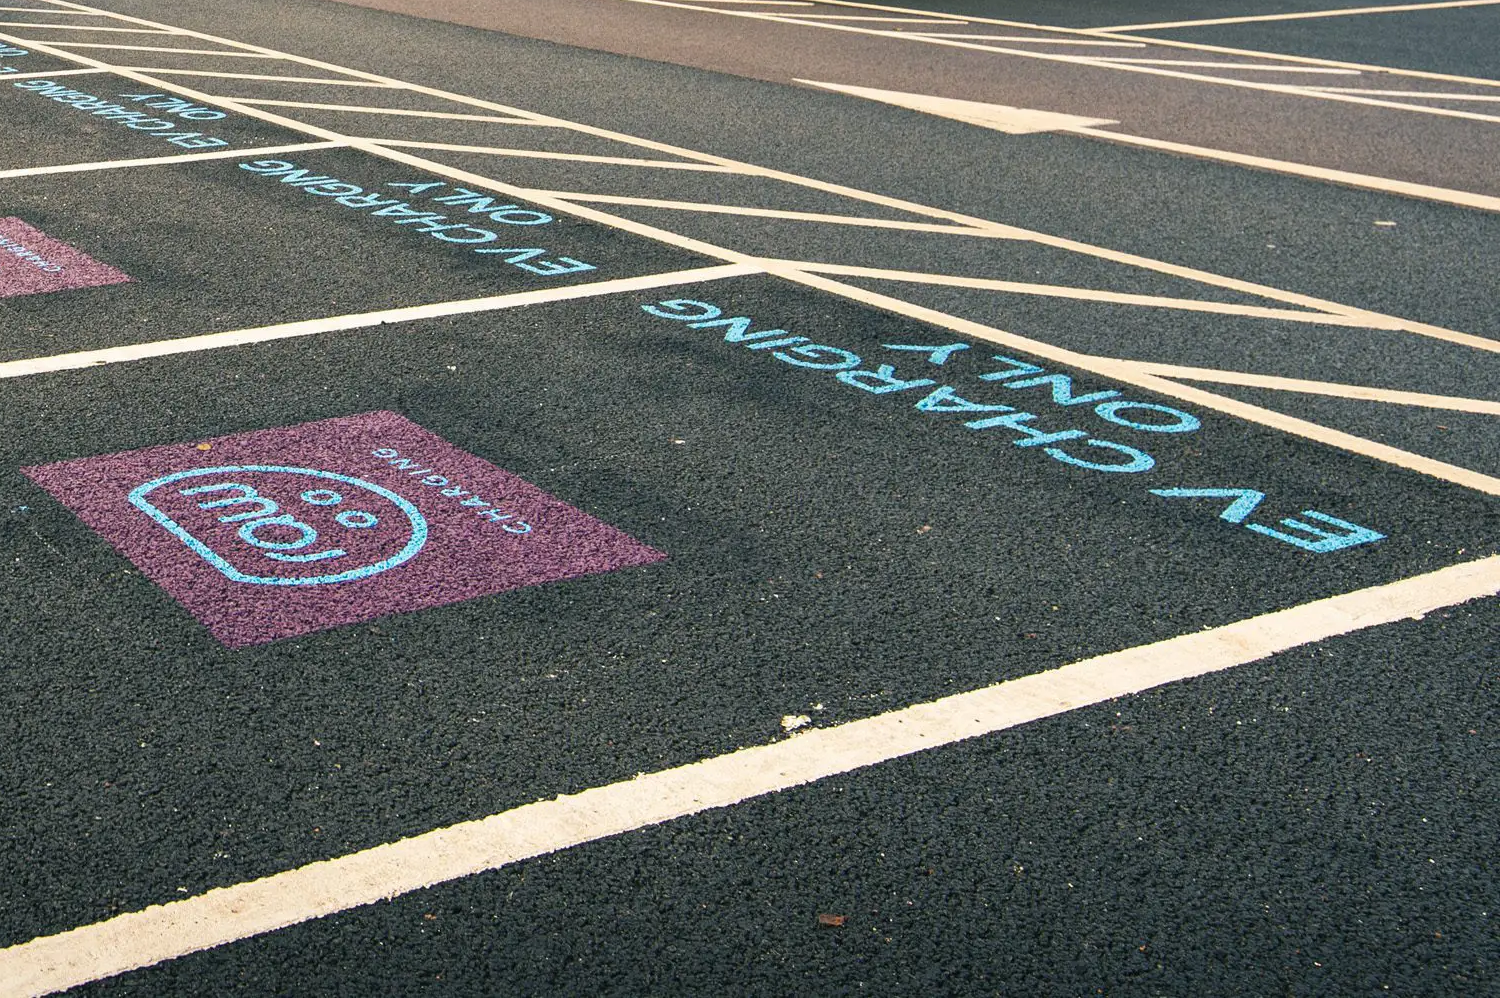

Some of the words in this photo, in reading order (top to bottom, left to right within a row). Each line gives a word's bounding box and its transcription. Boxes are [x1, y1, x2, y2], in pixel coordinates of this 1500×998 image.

[13, 80, 175, 130] CHARGING
[118, 93, 227, 120] ONLY
[150, 132, 229, 149] EV
[238, 159, 498, 244] CHARGING
[388, 181, 553, 226] ONLY
[474, 247, 597, 276] EV
[641, 298, 1156, 474] CHARGING
[881, 342, 1201, 435] ONLY
[372, 447, 532, 536] CHARGING
[1149, 486, 1388, 554] EV
